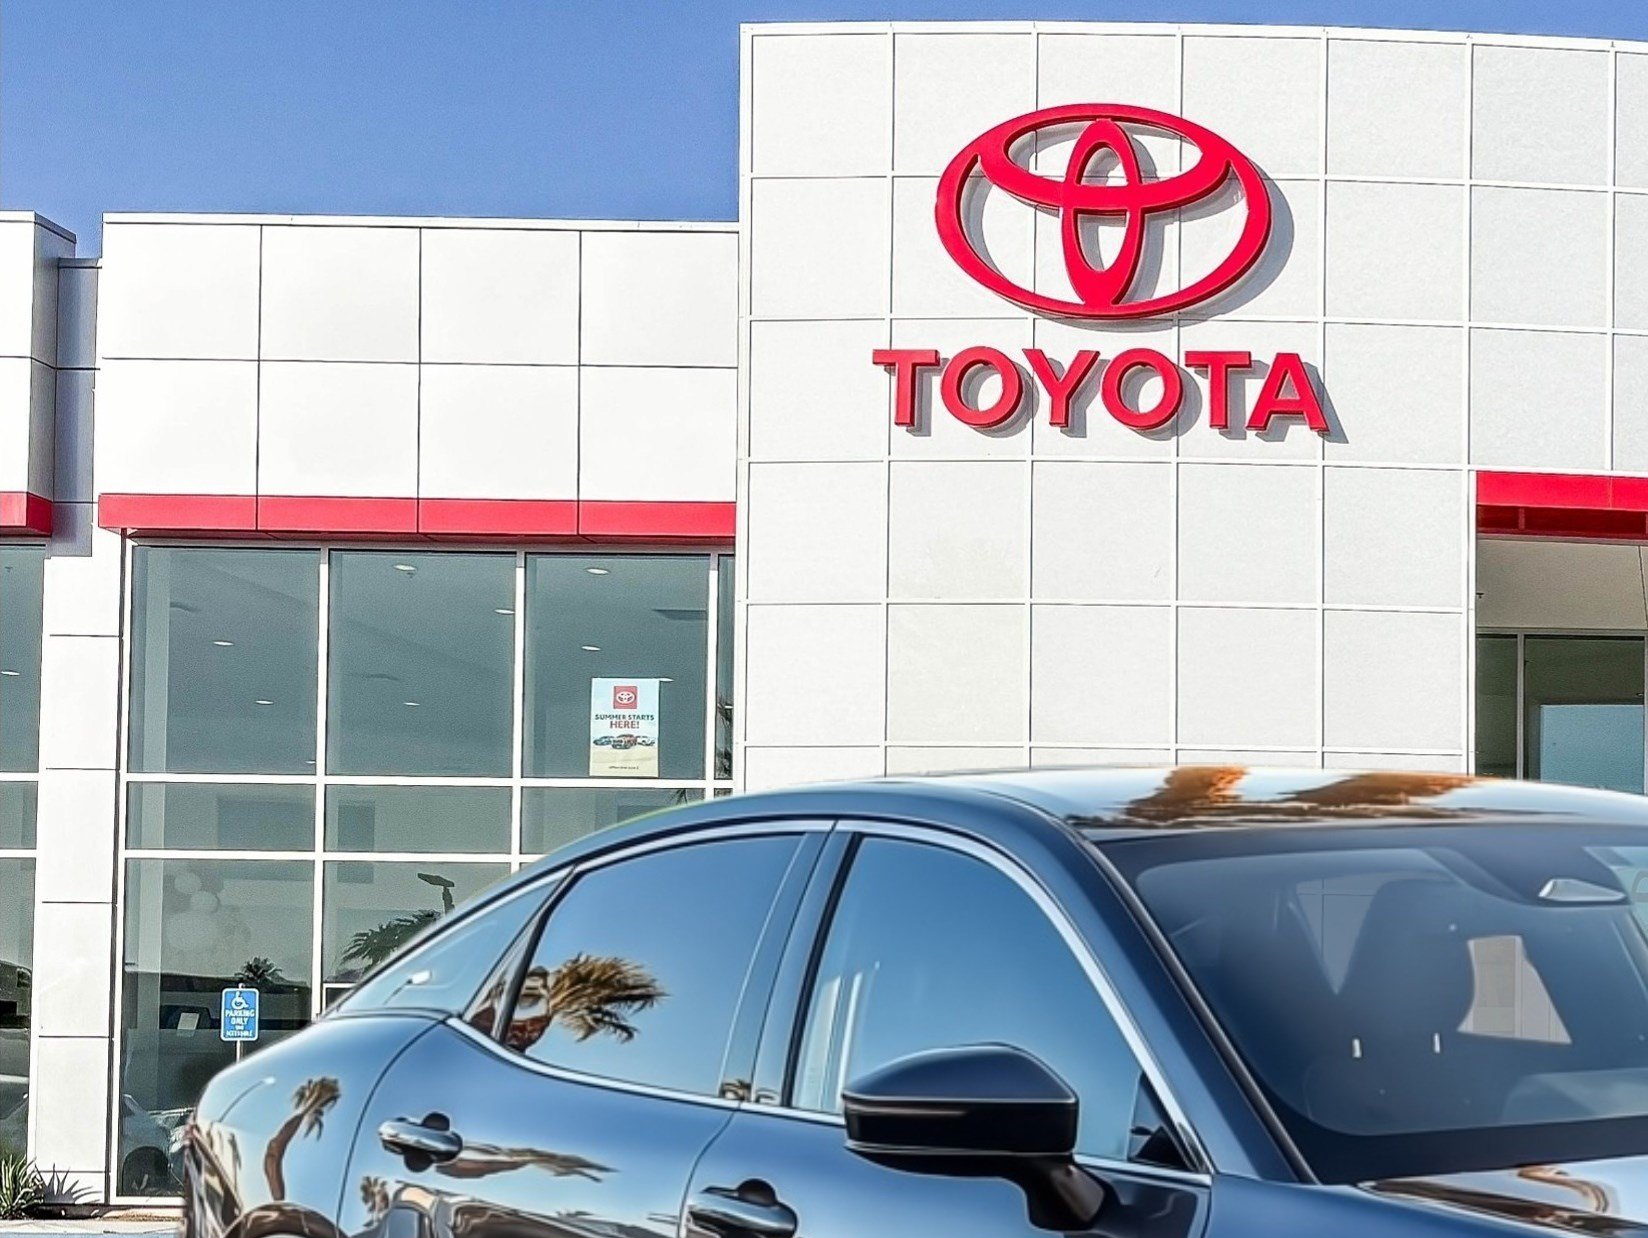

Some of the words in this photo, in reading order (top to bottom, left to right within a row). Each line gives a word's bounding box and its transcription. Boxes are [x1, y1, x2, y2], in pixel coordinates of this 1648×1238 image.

[872, 345, 1330, 434] TOYOTA
[609, 720, 640, 729] HERE!
[225, 1009, 255, 1017] PARKING
